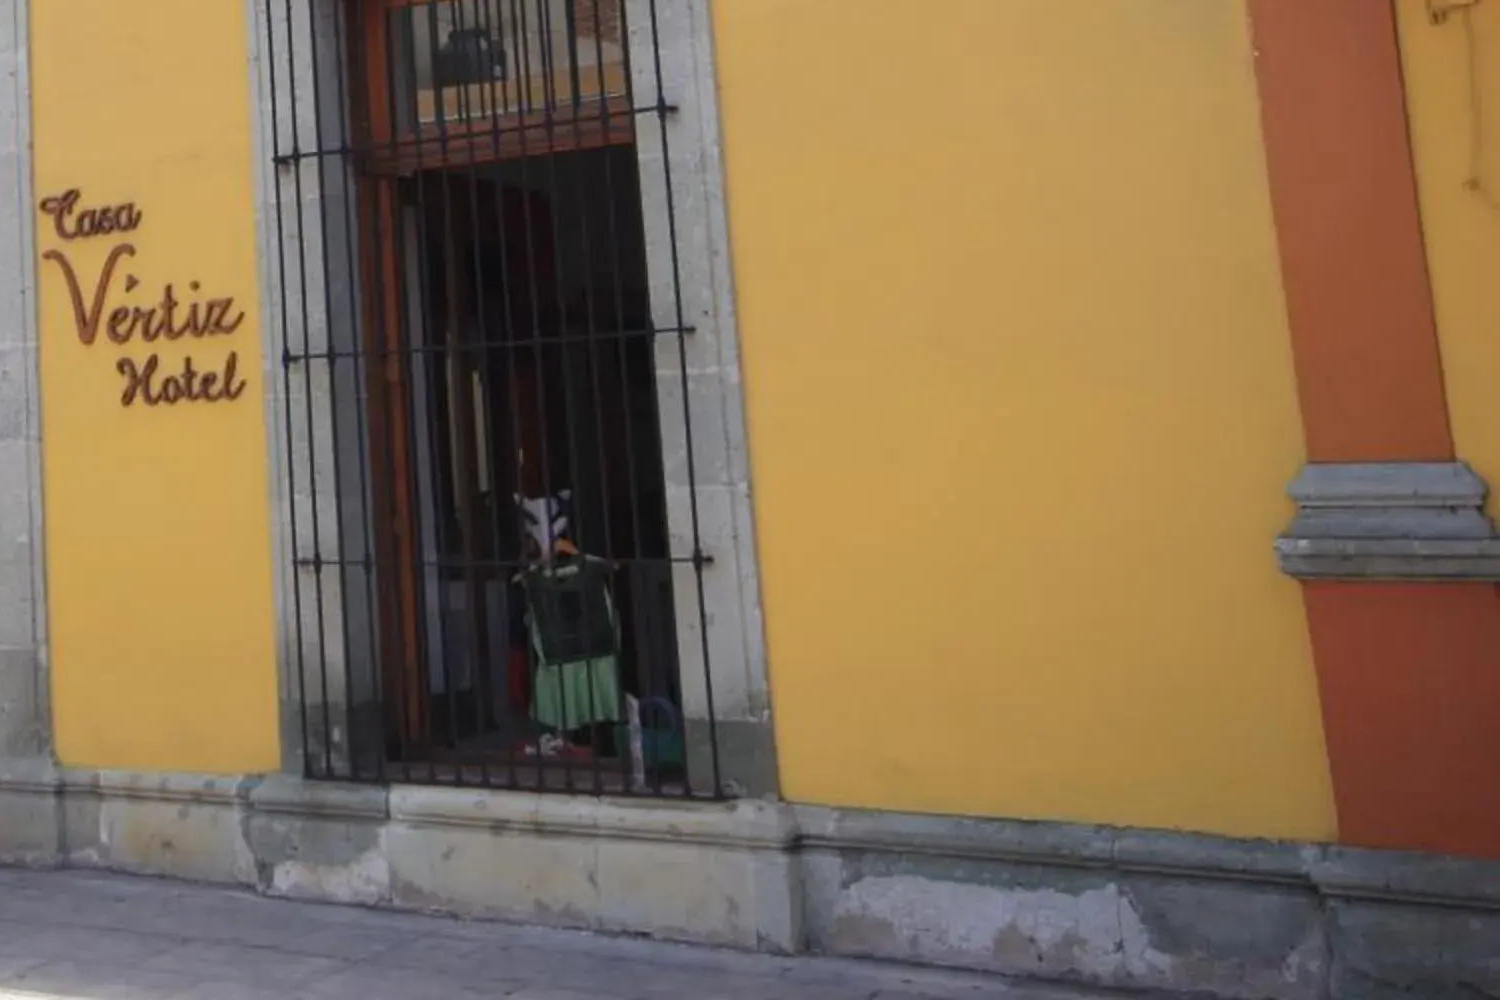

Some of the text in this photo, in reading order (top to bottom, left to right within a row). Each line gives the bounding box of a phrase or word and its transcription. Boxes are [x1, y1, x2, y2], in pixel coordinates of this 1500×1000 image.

[39, 187, 142, 240] Casa
[42, 243, 245, 345] Vértiz
[116, 351, 246, 408] Hotel
